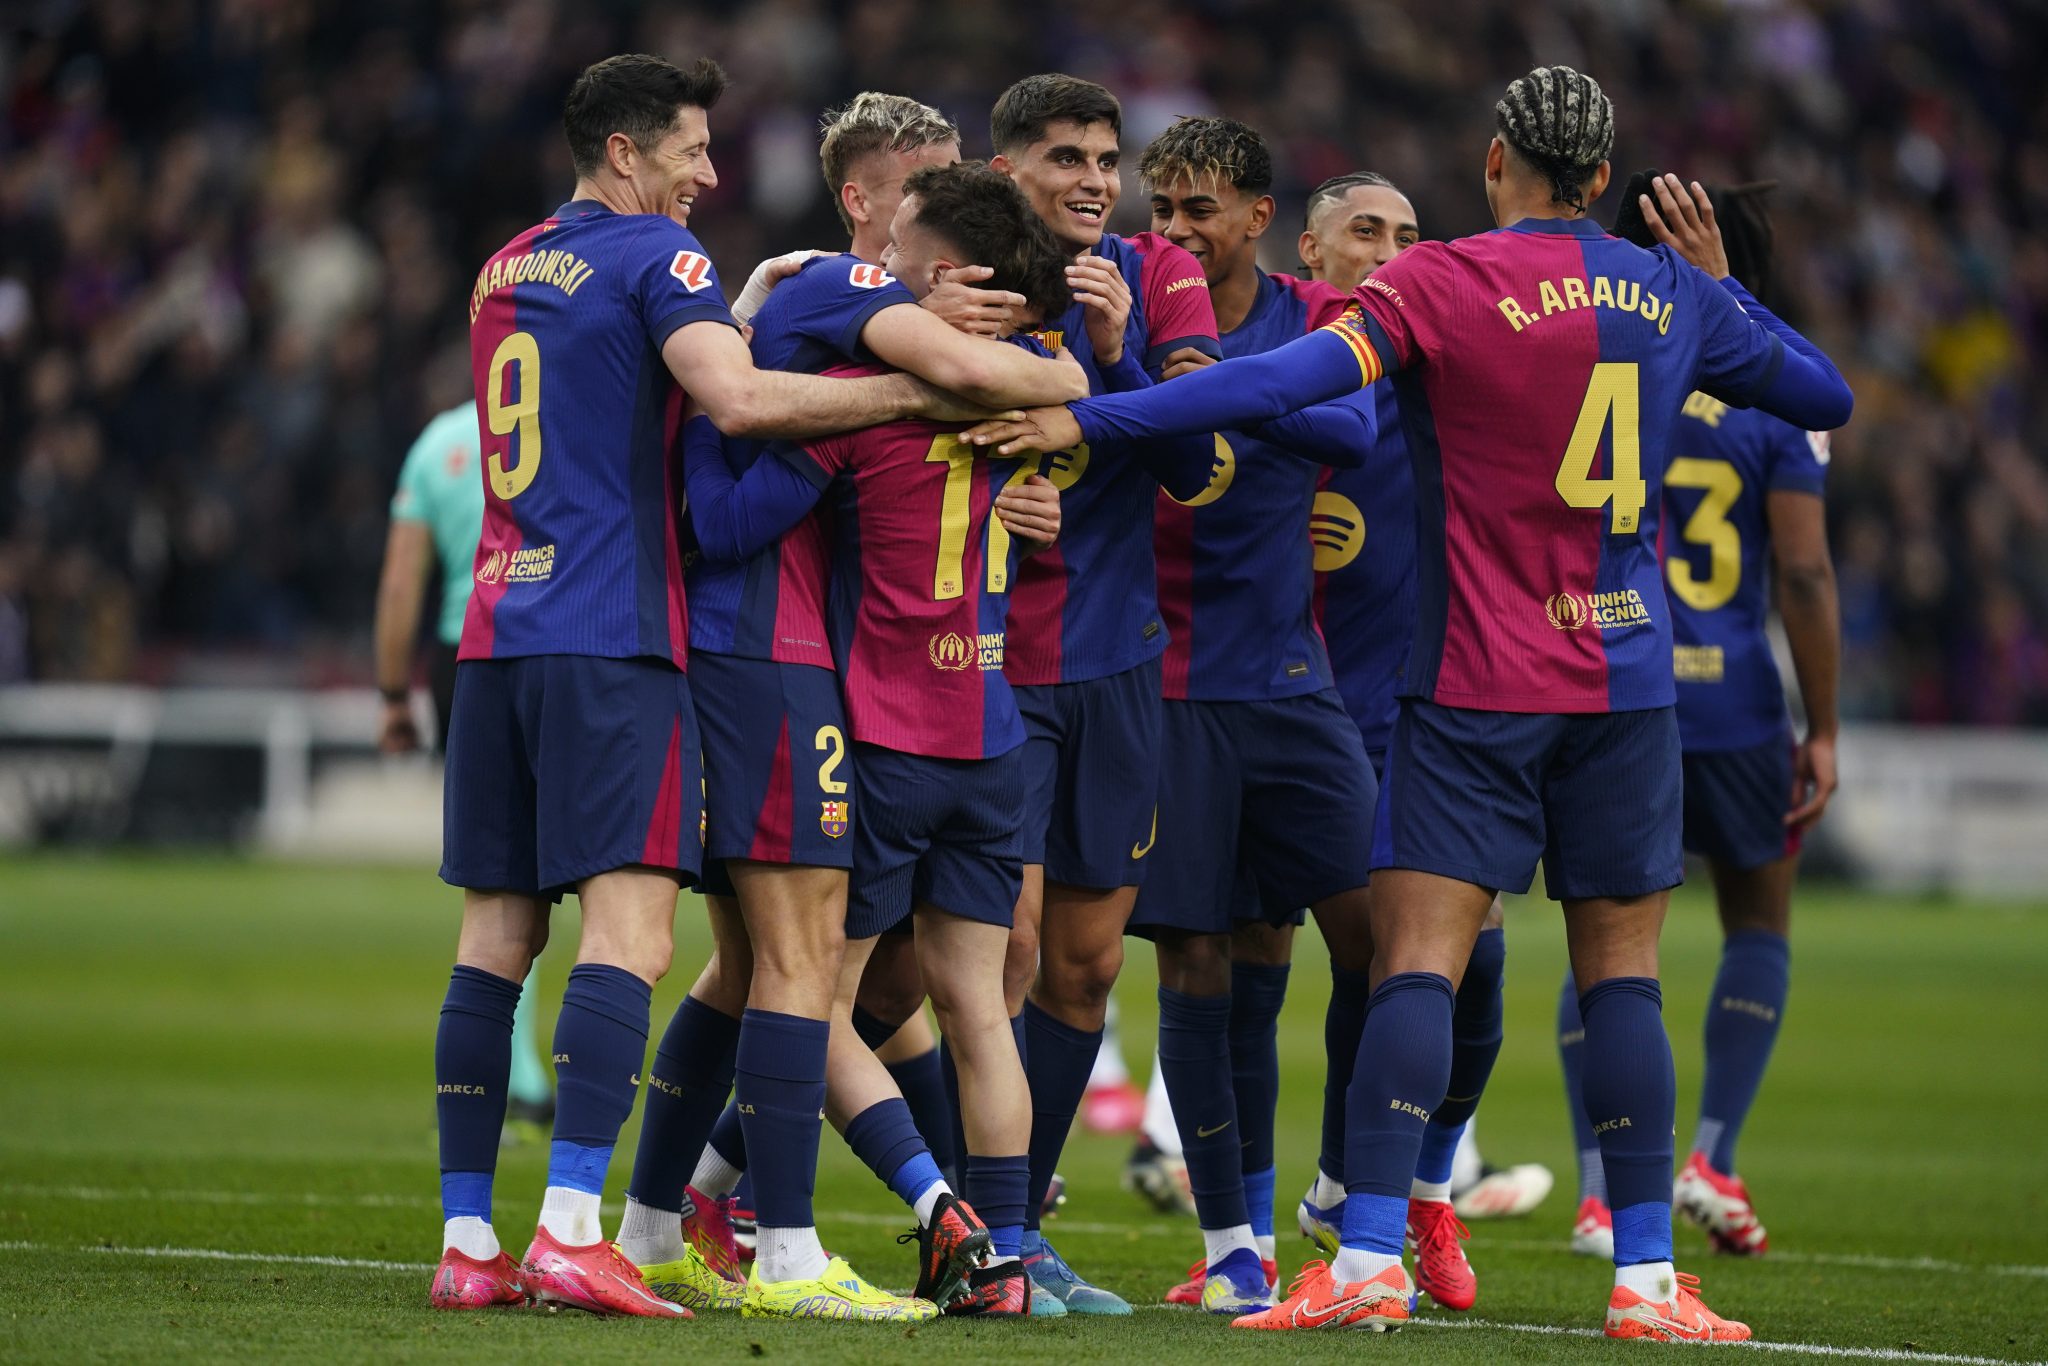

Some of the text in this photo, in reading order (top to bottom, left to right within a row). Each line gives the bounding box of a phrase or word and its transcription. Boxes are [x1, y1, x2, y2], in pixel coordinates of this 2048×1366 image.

[470, 249, 594, 325] LEWANDOWSKI
[487, 331, 542, 501] 9
[1554, 362, 1647, 535] 4
[504, 559, 553, 577] ACNUR
[510, 544, 555, 563] UNHCR
[1587, 588, 1642, 609] UNHCR
[1592, 603, 1649, 623] ACNUR
[814, 724, 848, 794] 2
